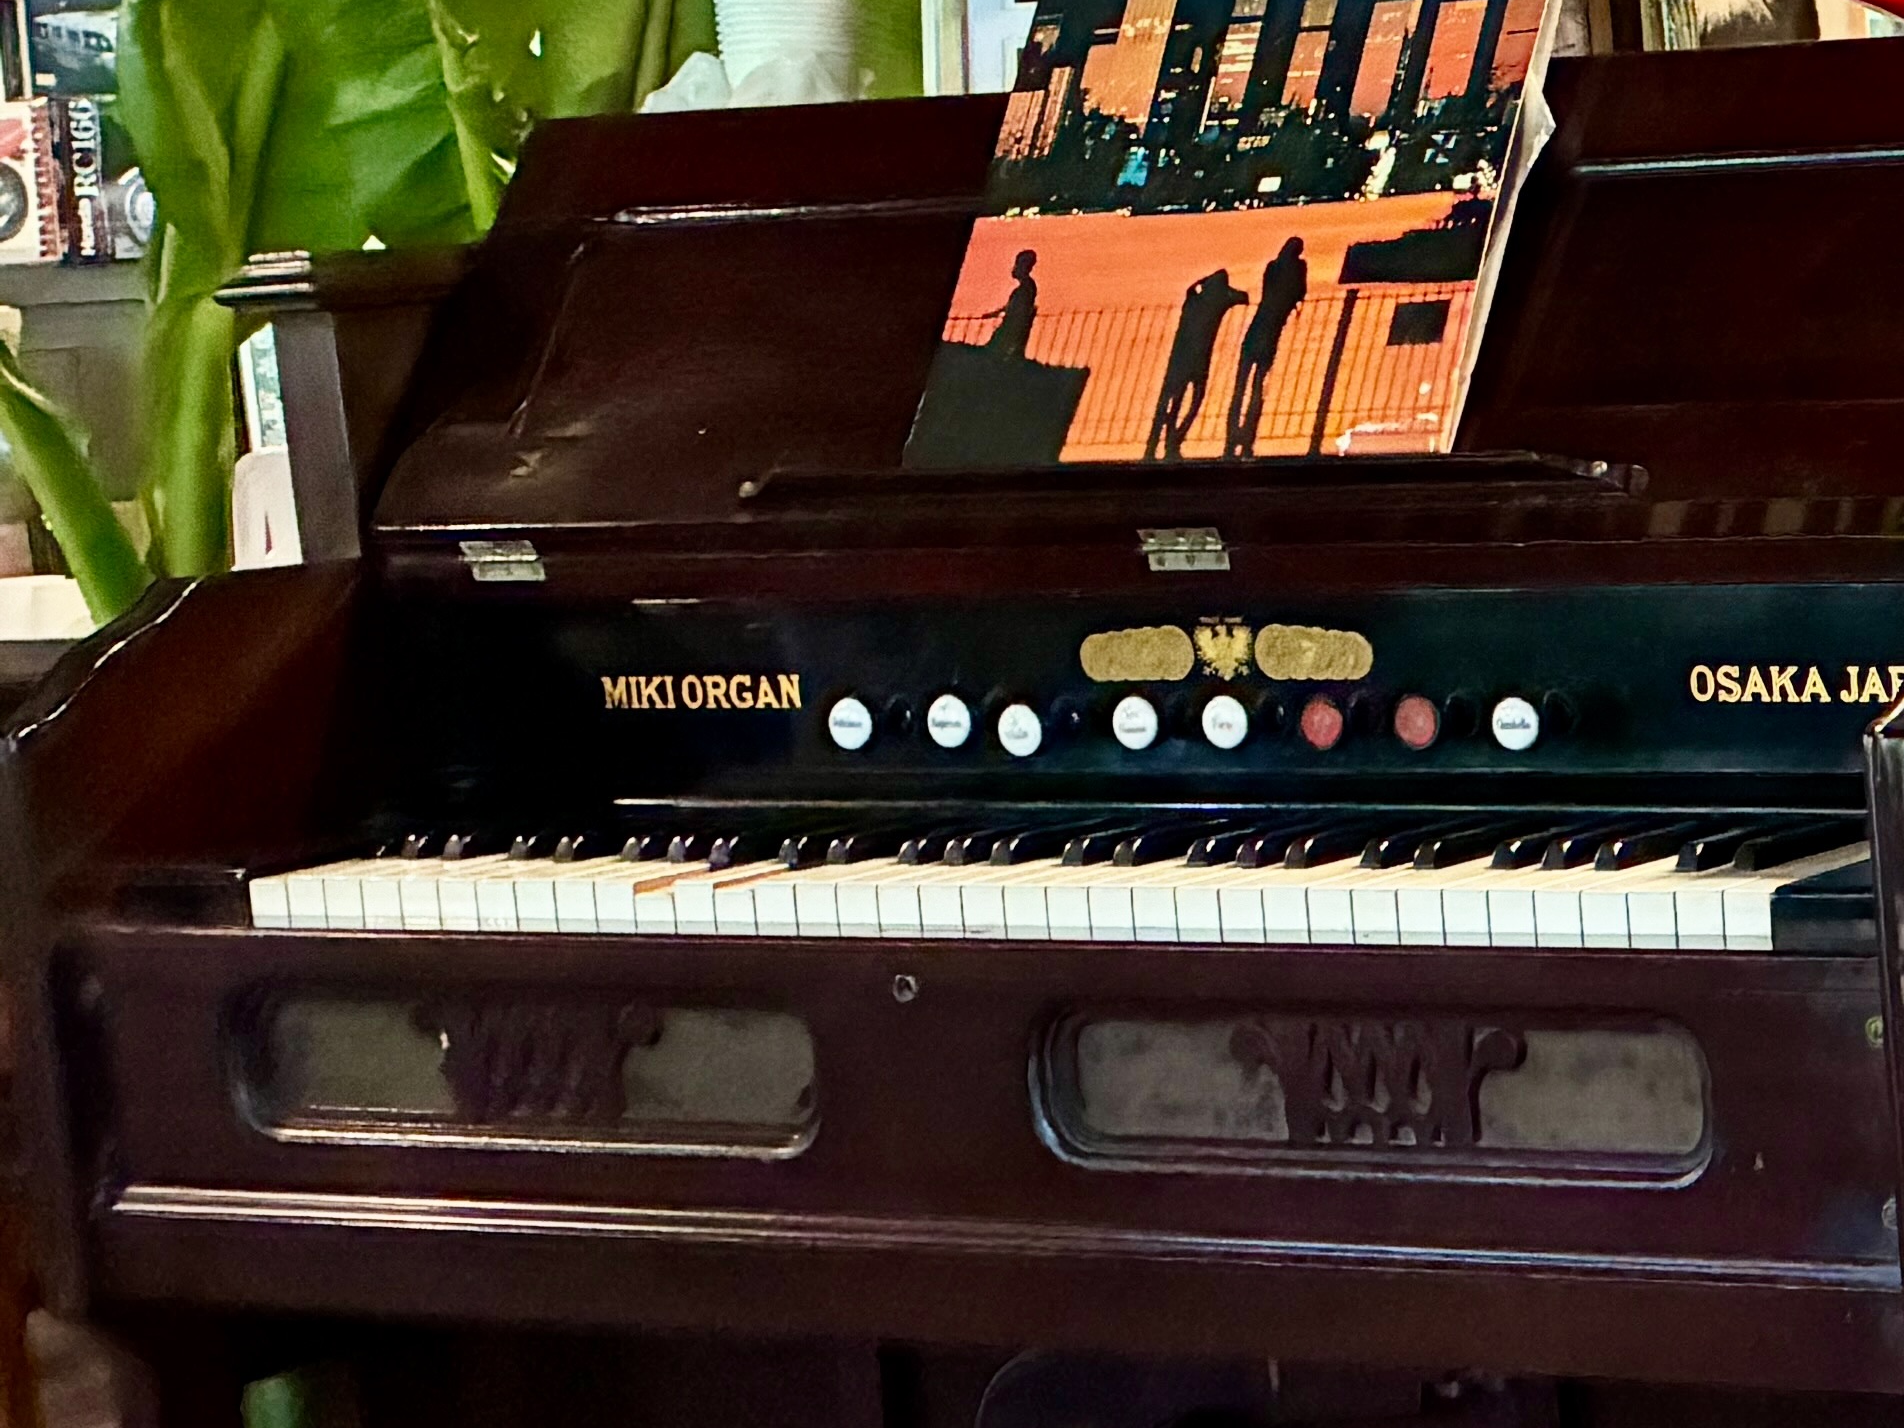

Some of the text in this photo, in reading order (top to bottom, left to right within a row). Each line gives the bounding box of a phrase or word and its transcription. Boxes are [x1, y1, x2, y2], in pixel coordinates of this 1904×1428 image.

[602, 673, 802, 710] MIKI ORGAN
[1690, 665, 1829, 704] OSAKA
